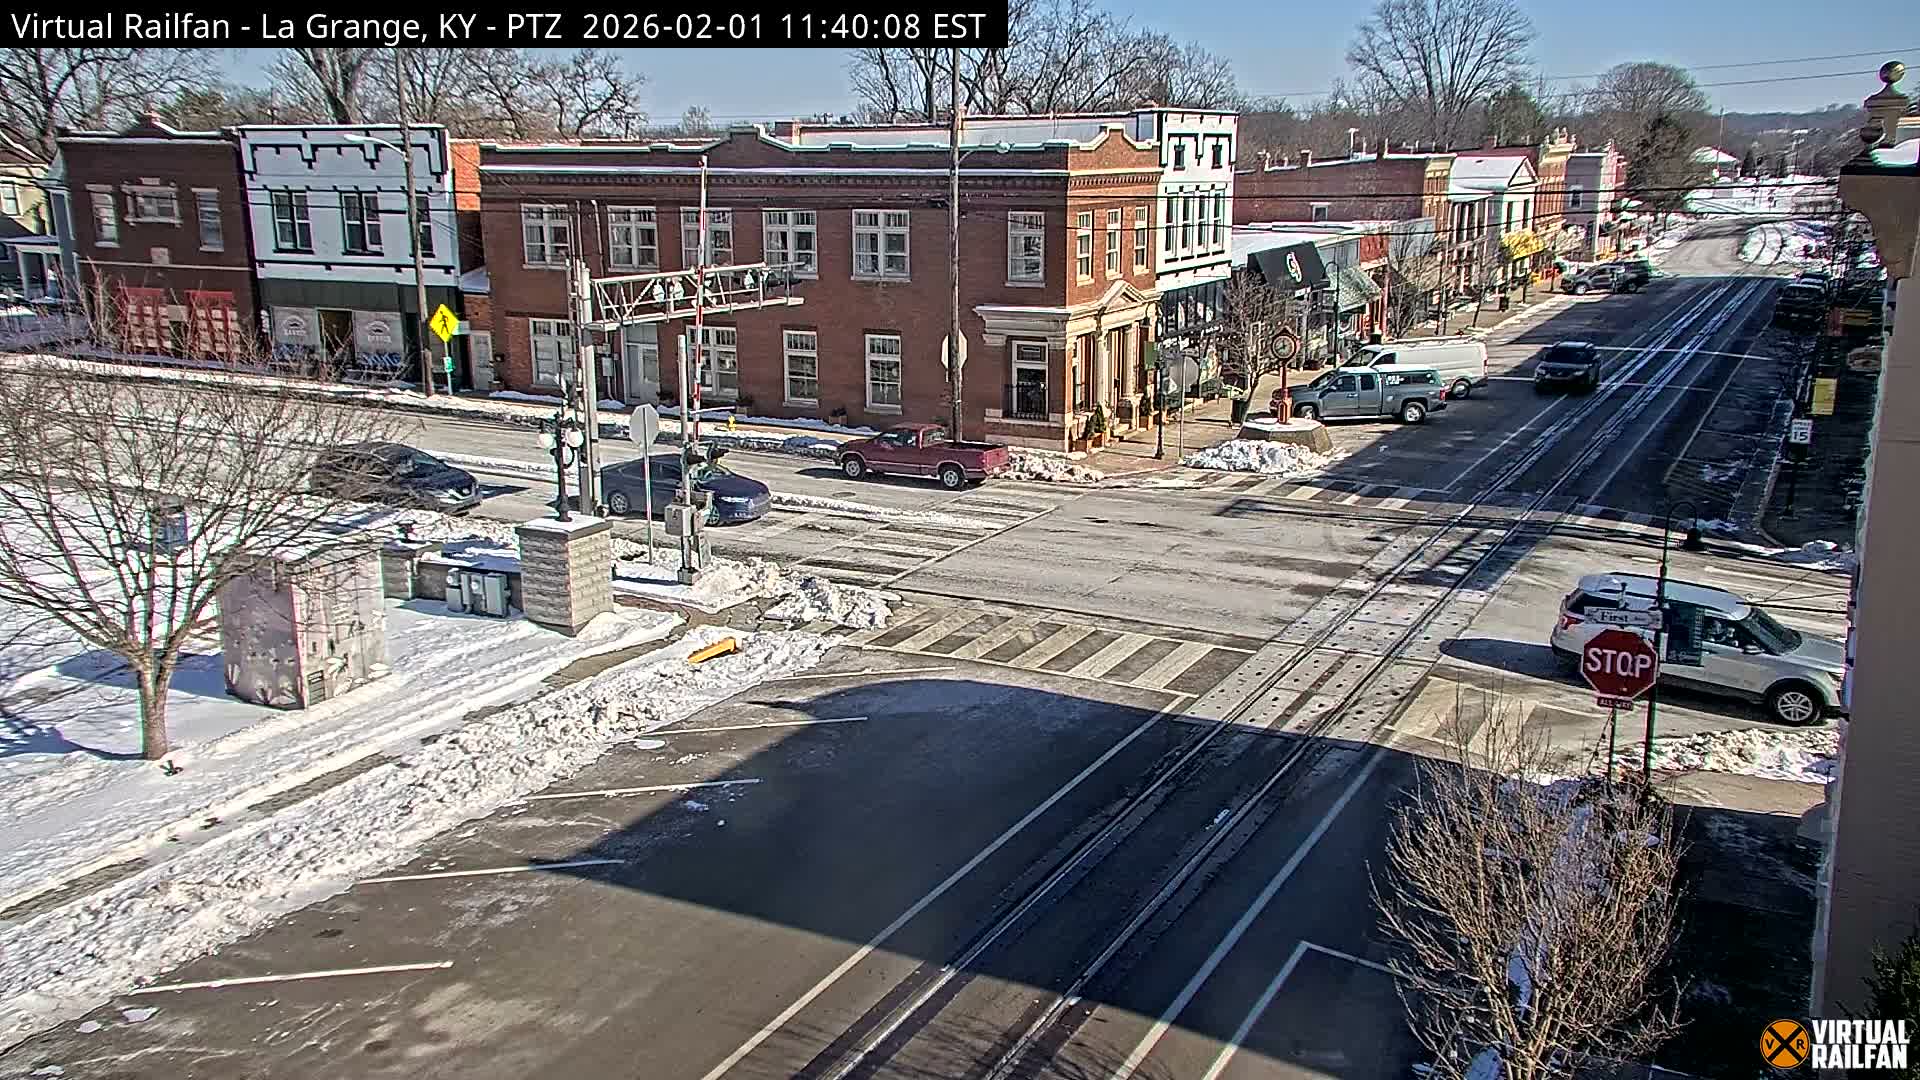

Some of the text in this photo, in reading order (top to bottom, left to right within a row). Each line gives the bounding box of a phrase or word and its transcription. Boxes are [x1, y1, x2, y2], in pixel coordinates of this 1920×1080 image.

[1793, 431, 1808, 441] 15
[1600, 611, 1629, 622] First
[1585, 647, 1652, 678] STOP
